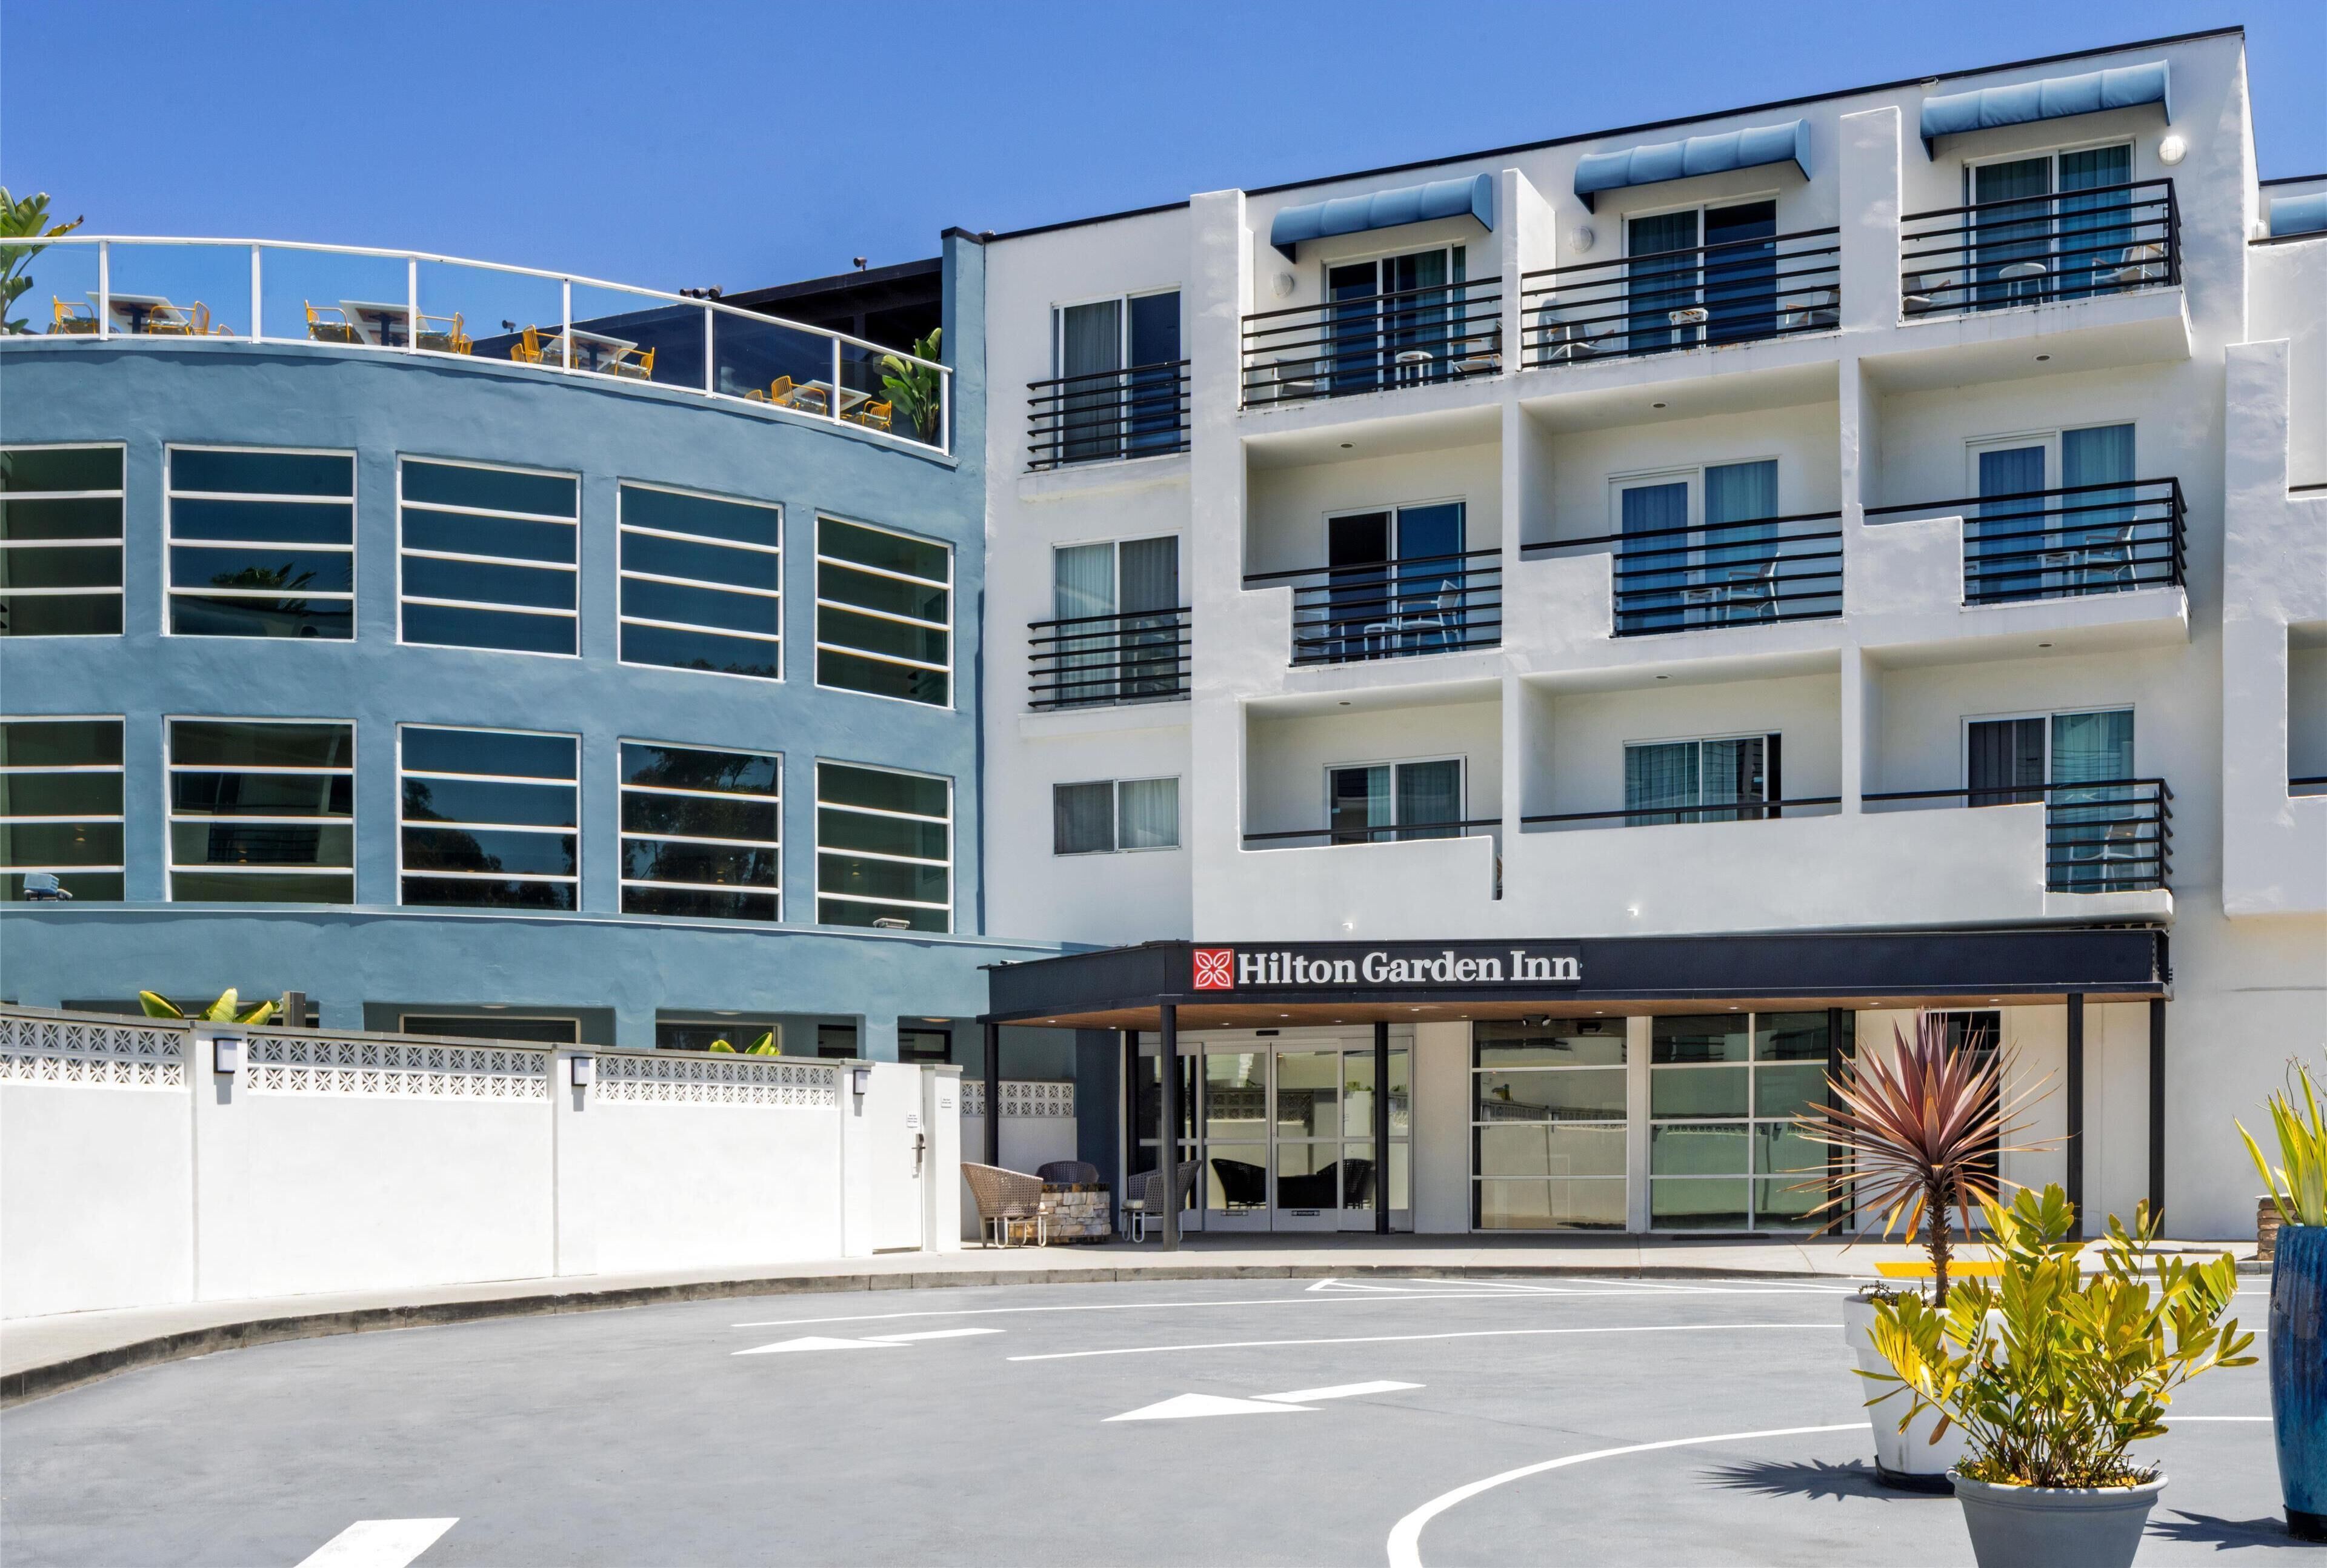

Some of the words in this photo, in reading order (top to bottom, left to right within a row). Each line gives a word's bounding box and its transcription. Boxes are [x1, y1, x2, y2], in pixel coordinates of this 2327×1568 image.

[1238, 952, 1357, 984] Hilton
[1362, 951, 1504, 983] Garden
[1510, 950, 1581, 981] Inn
